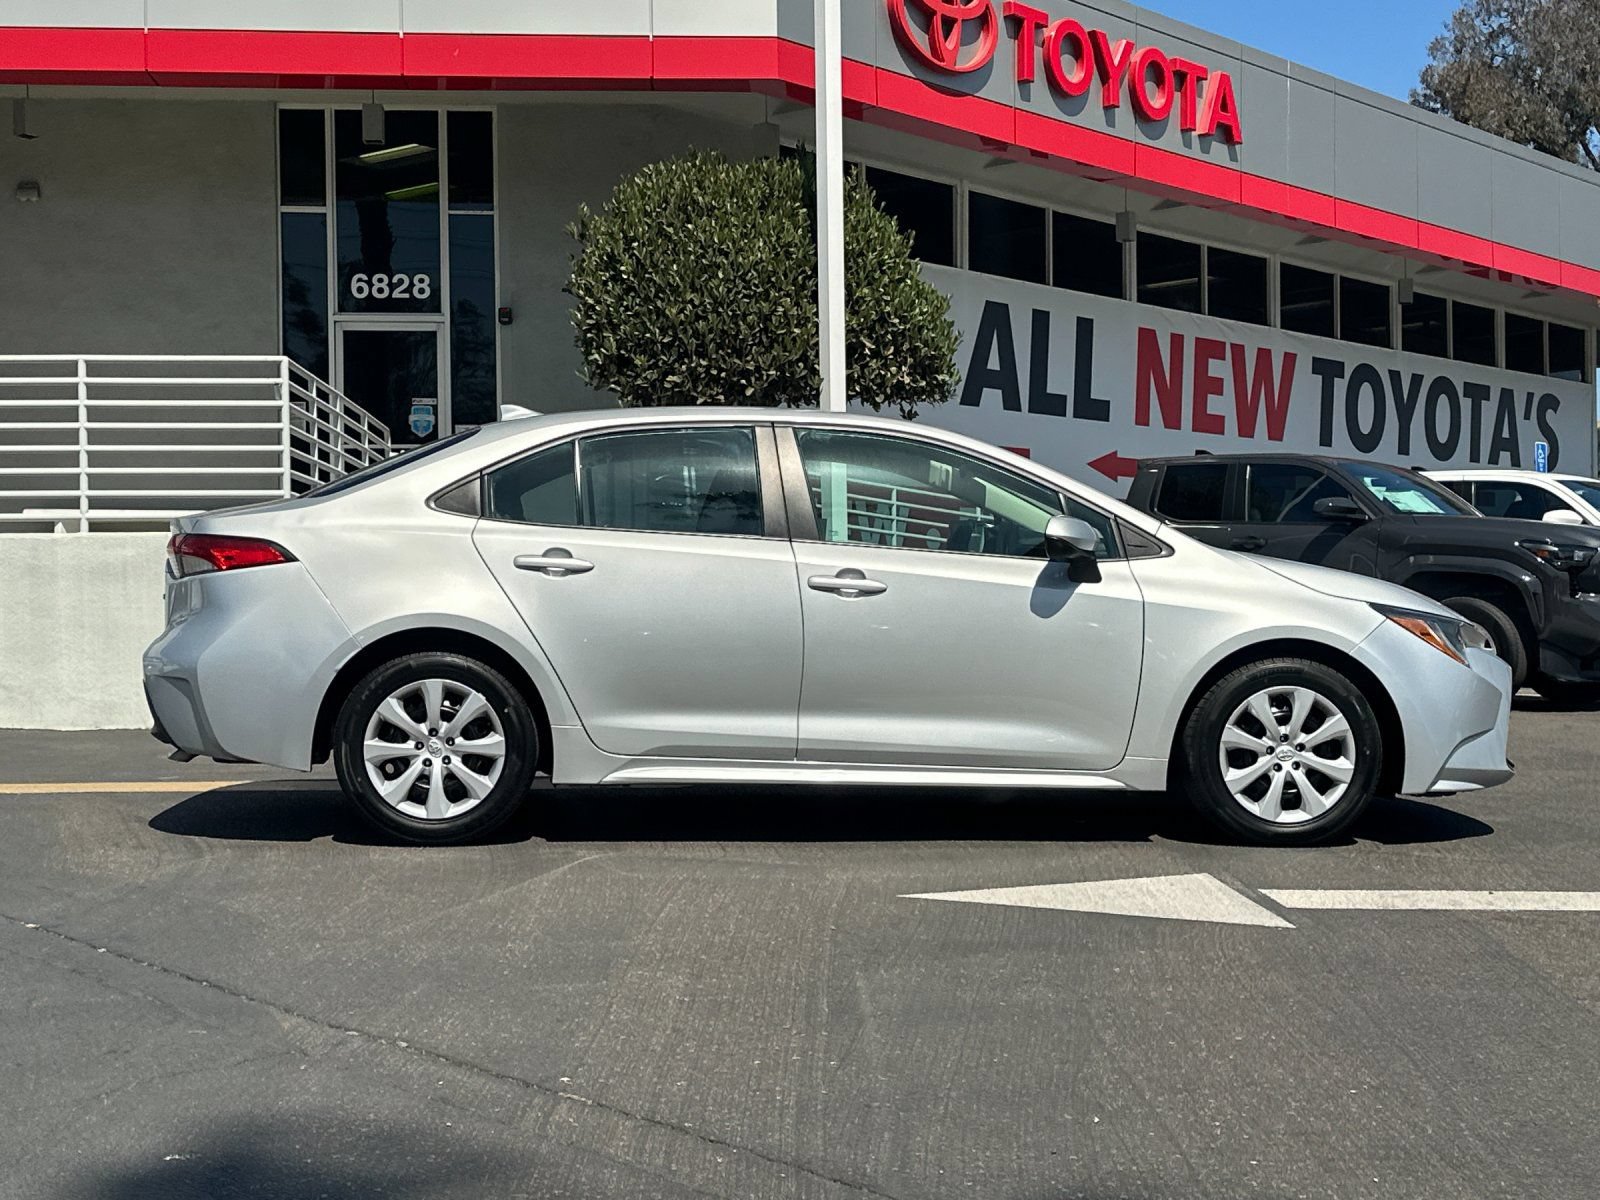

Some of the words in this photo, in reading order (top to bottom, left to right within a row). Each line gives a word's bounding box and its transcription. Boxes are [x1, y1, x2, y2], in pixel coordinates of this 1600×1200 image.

[1003, 0, 1242, 144] TOYOTA
[351, 273, 431, 299] 6828
[959, 300, 1110, 422] ALL
[1135, 327, 1297, 442] NEW
[1312, 356, 1560, 473] TOYOTA'S
